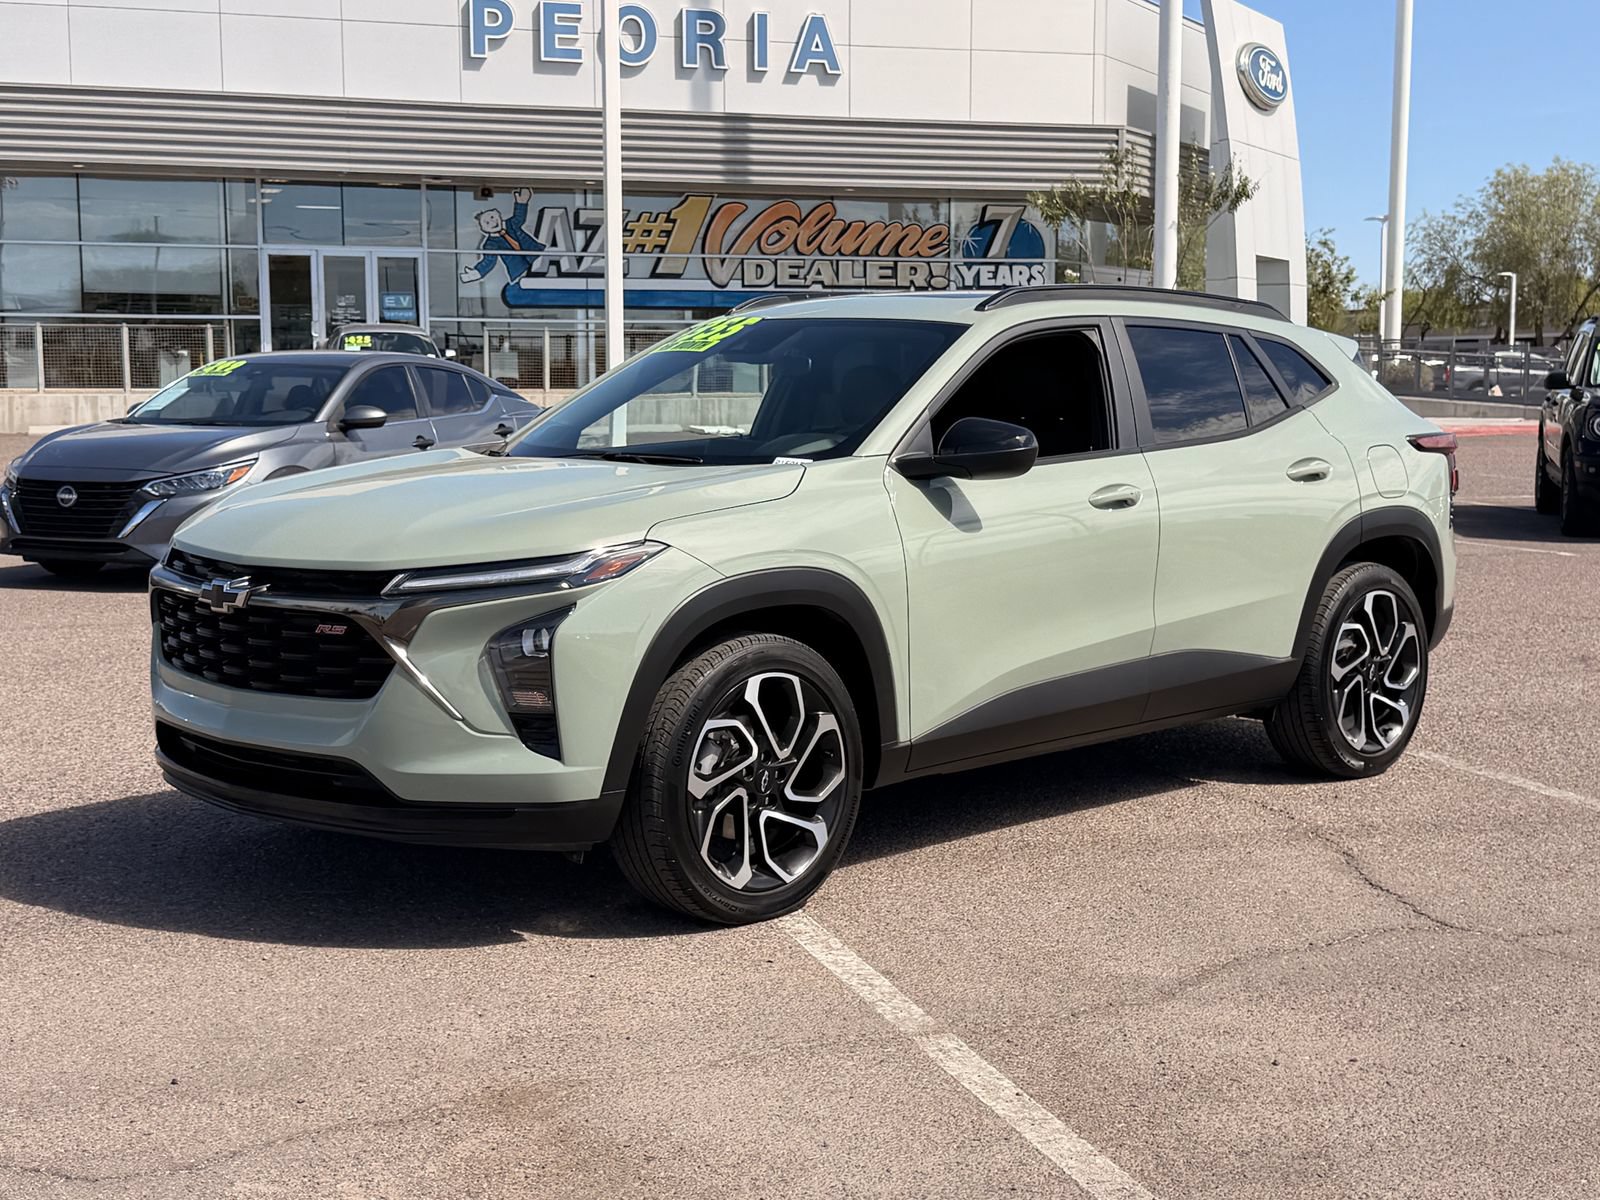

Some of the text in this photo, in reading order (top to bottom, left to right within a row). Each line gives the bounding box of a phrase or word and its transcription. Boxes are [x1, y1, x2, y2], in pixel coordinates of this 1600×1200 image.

[469, 0, 842, 75] PEORIA
[1258, 54, 1284, 94] Ford
[525, 193, 950, 289] AZ #1 Volume
[980, 203, 1026, 260] 7
[741, 258, 951, 290] DEALER!
[955, 261, 1047, 288] YEARS
[314, 624, 348, 635] RS
